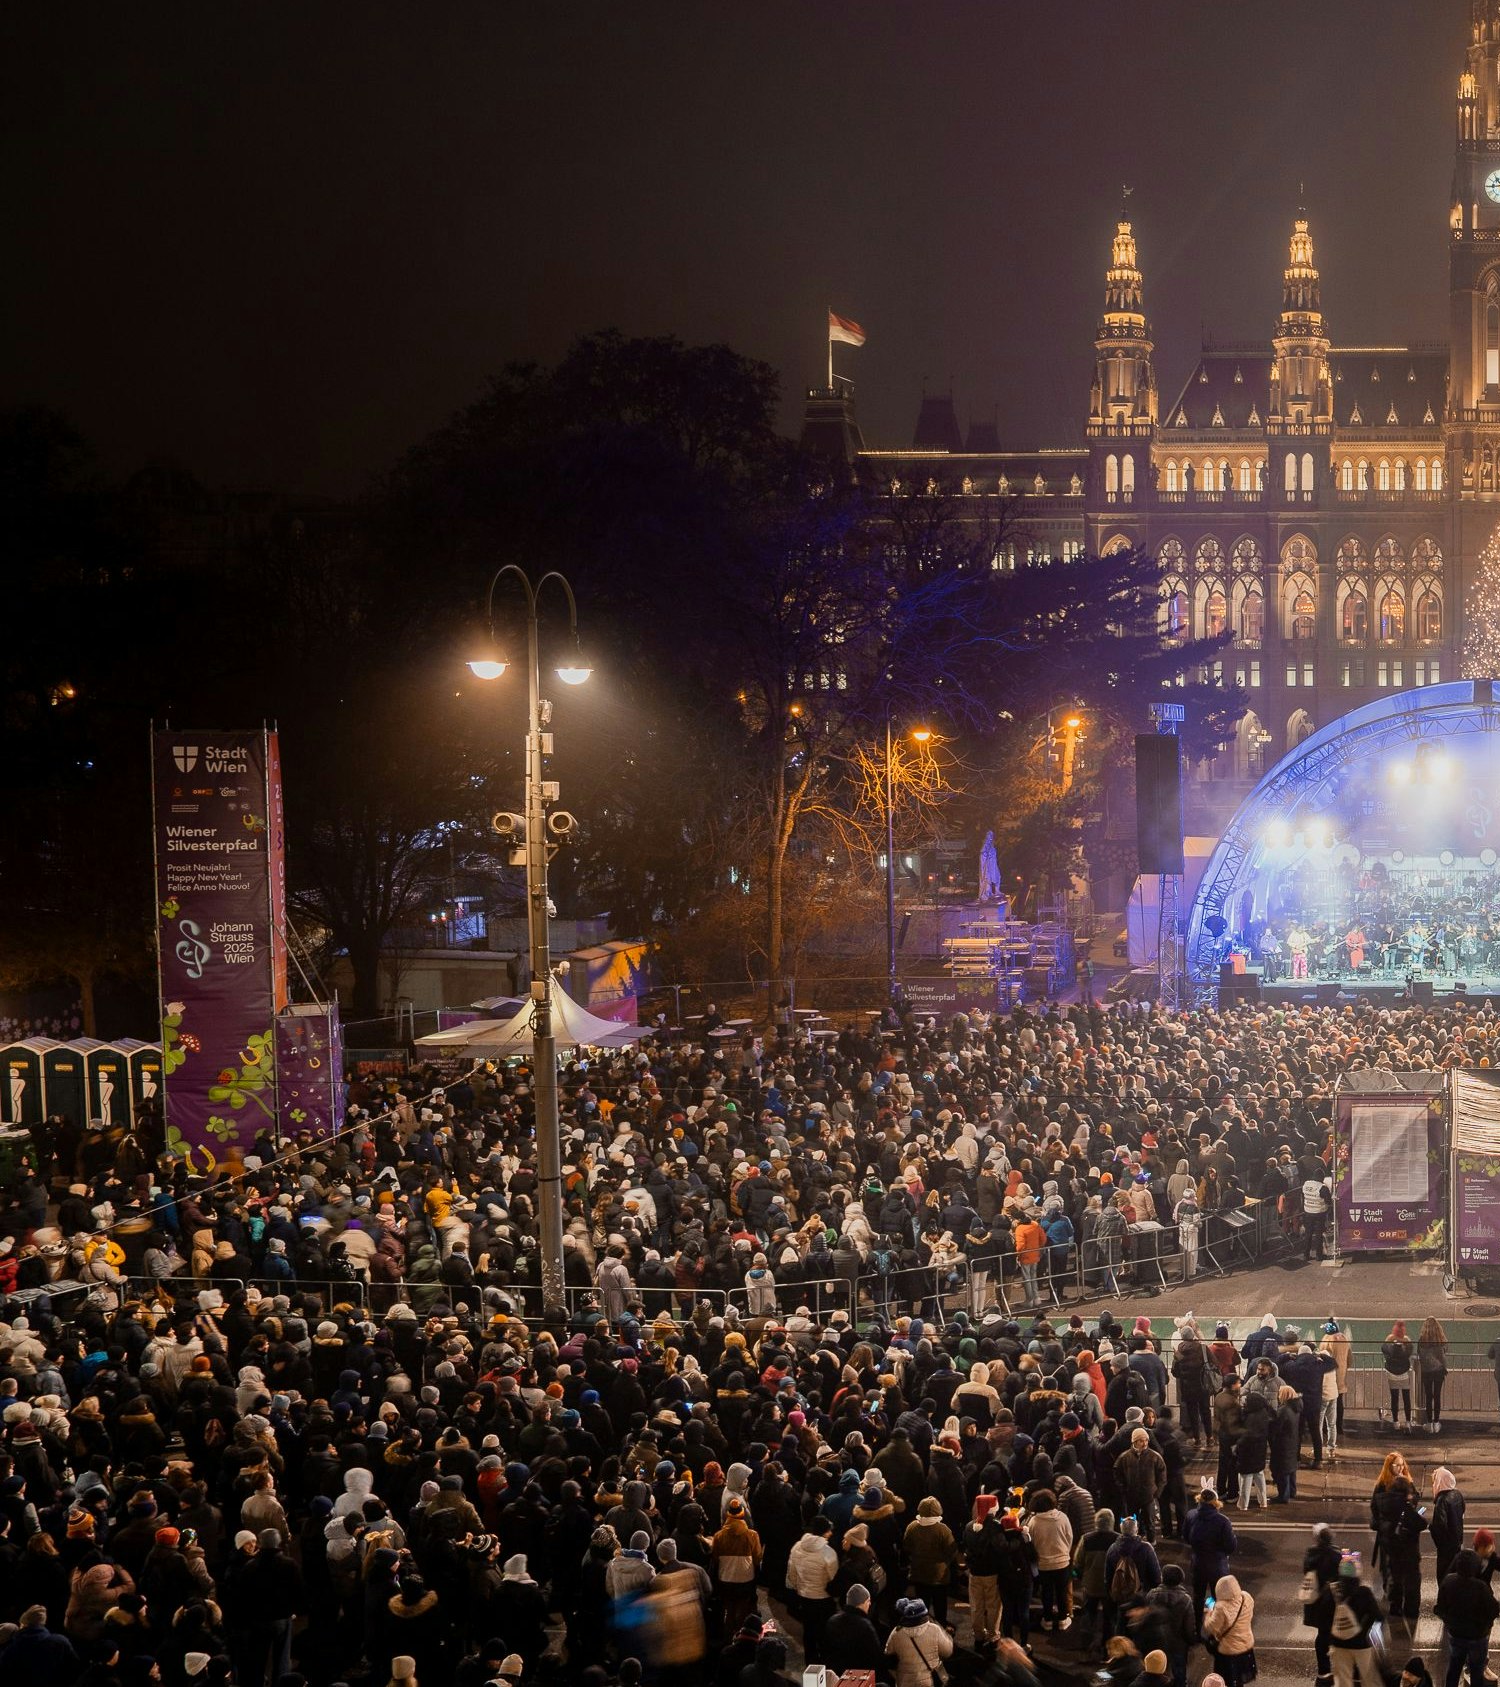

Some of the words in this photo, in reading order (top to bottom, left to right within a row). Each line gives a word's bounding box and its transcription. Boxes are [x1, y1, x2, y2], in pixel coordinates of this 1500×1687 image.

[206, 746, 247, 759] Stadt
[205, 760, 247, 773] Wien
[166, 826, 217, 837] Wiener
[167, 839, 257, 853] Silvesterpfad
[167, 864, 191, 872] Prosit
[193, 864, 231, 873] Neujahr!
[167, 874, 196, 883] Happy
[168, 883, 191, 891] Felice
[193, 883, 217, 891] Anno
[219, 883, 250, 891] Nuovo!
[210, 922, 253, 932] Johann
[210, 932, 254, 943] Strauss
[224, 944, 254, 953] 2025
[224, 954, 255, 964] Wien
[908, 985, 935, 993] Wiener
[907, 993, 956, 1003] Silvesterpfad
[1363, 1208, 1383, 1216] Stadt
